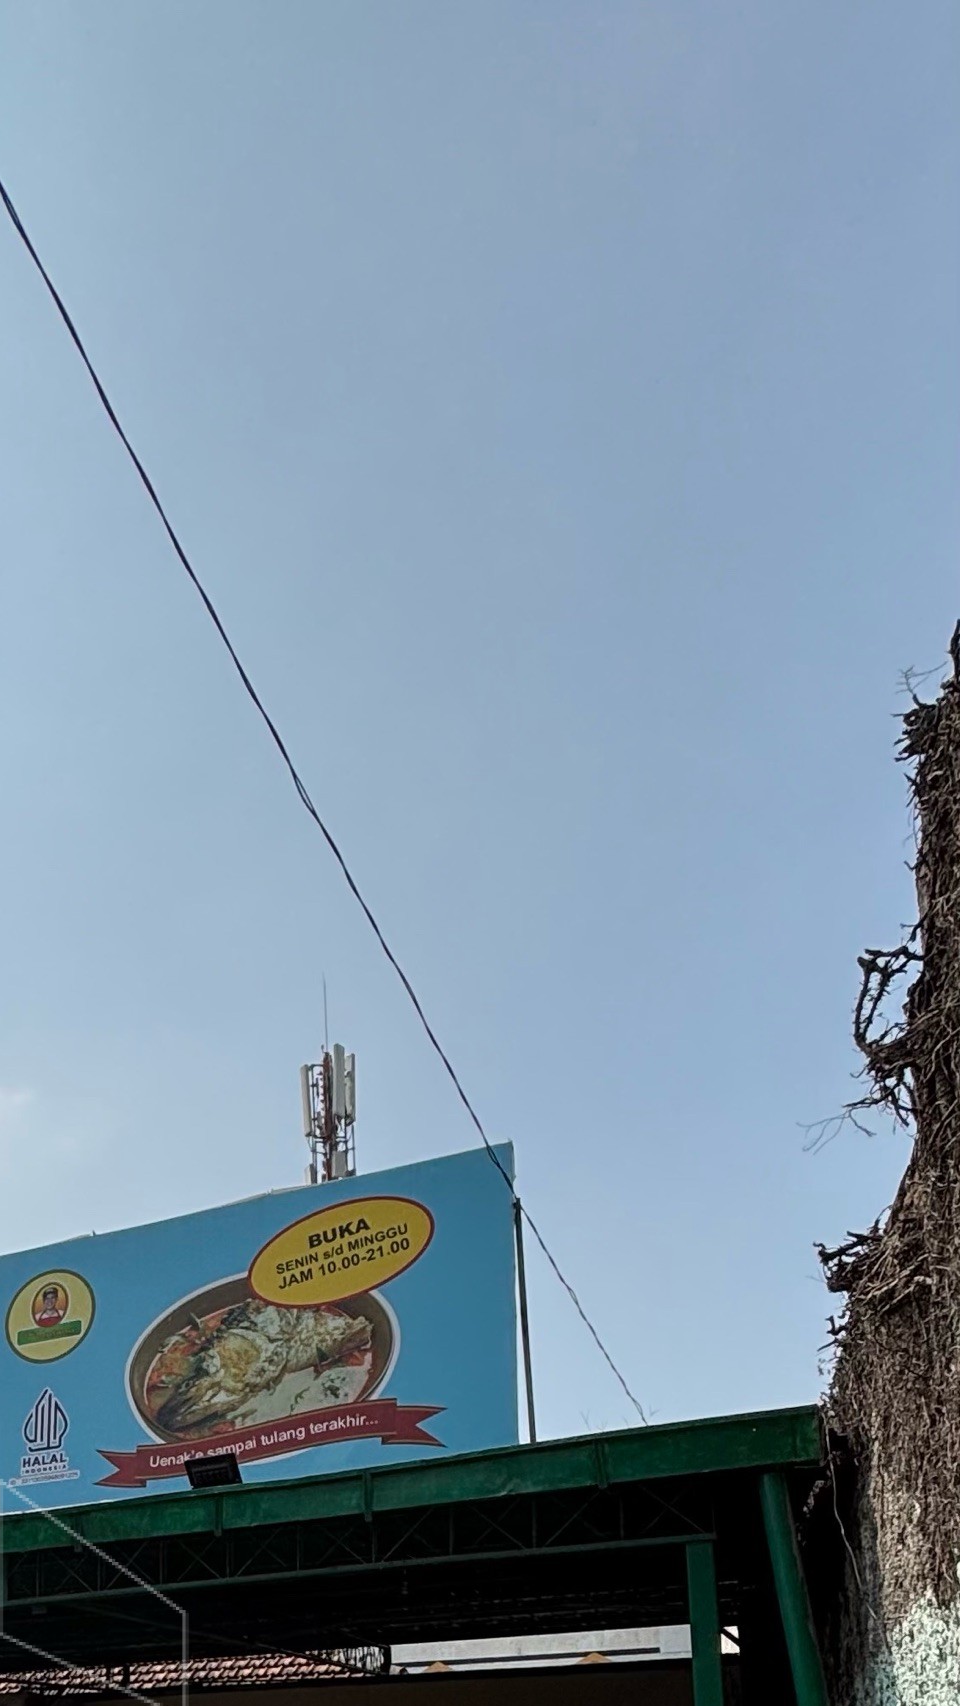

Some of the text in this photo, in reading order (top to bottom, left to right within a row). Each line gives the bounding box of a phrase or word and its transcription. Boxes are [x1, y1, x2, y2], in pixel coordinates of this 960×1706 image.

[276, 1223, 408, 1274] SENIN s/d MINGGU
[308, 1218, 370, 1248] BUKA
[279, 1238, 410, 1289] JAM 10.00-21.00
[260, 1426, 306, 1446] tulang
[309, 1413, 379, 1435] terakhir...
[22, 1453, 67, 1468] HALAL
[22, 1465, 66, 1475] INDONESIA
